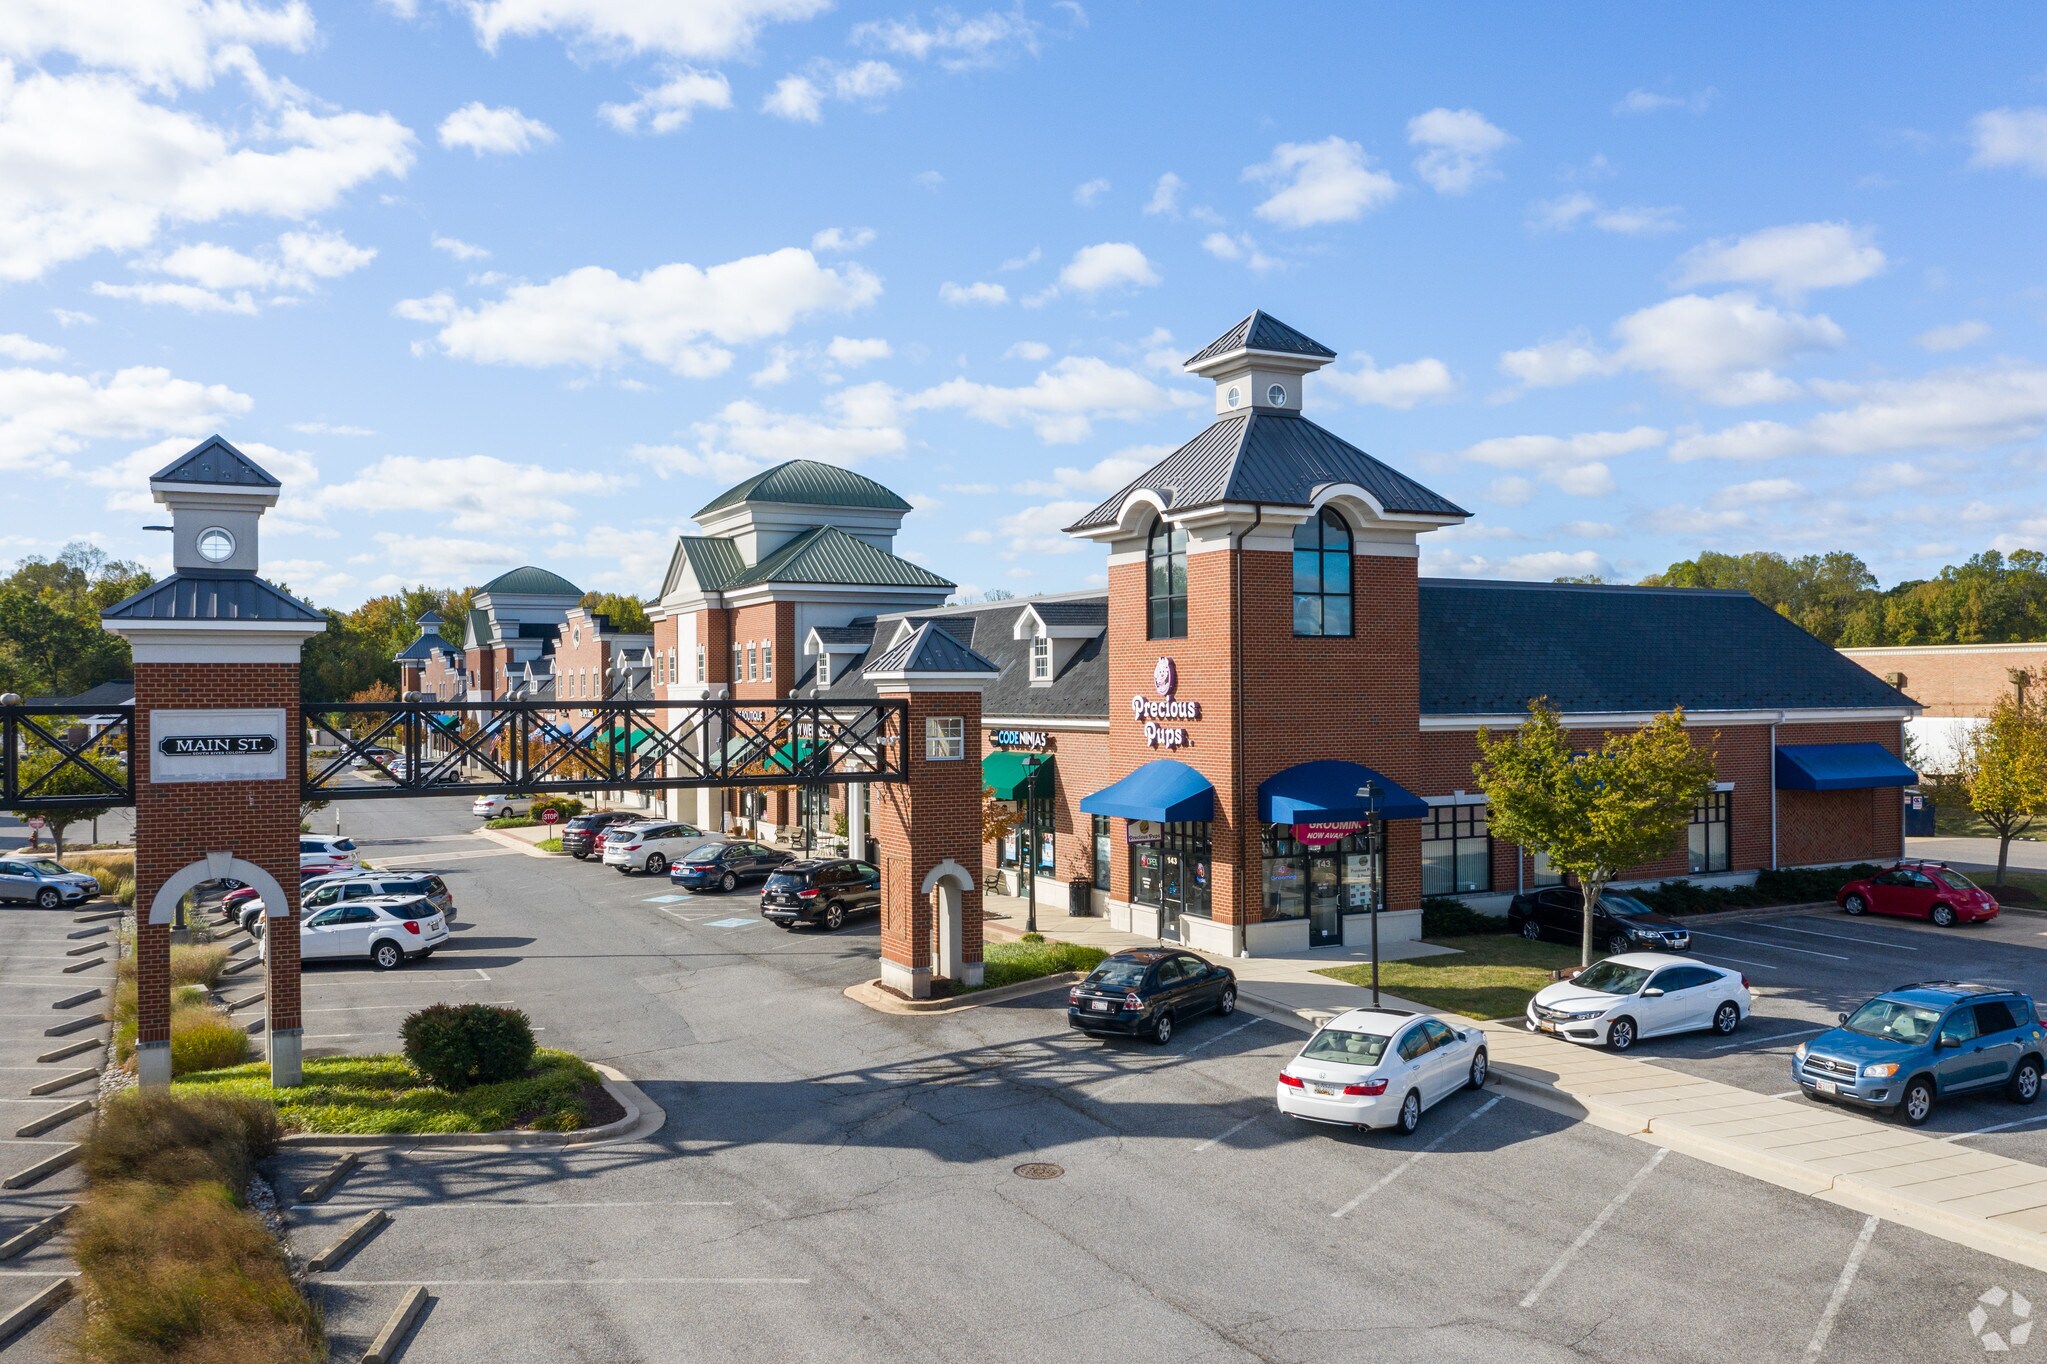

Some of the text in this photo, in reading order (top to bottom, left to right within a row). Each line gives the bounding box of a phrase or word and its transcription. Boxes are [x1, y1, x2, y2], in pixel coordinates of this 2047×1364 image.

[1132, 695, 1196, 720] Precious
[999, 731, 1047, 749] CODE NINJAS
[1144, 721, 1182, 749] Pups
[176, 738, 263, 752] MAIN ST.
[1309, 821, 1362, 829] GROOMIN
[1167, 856, 1178, 865] 143
[1317, 860, 1331, 868] 143
